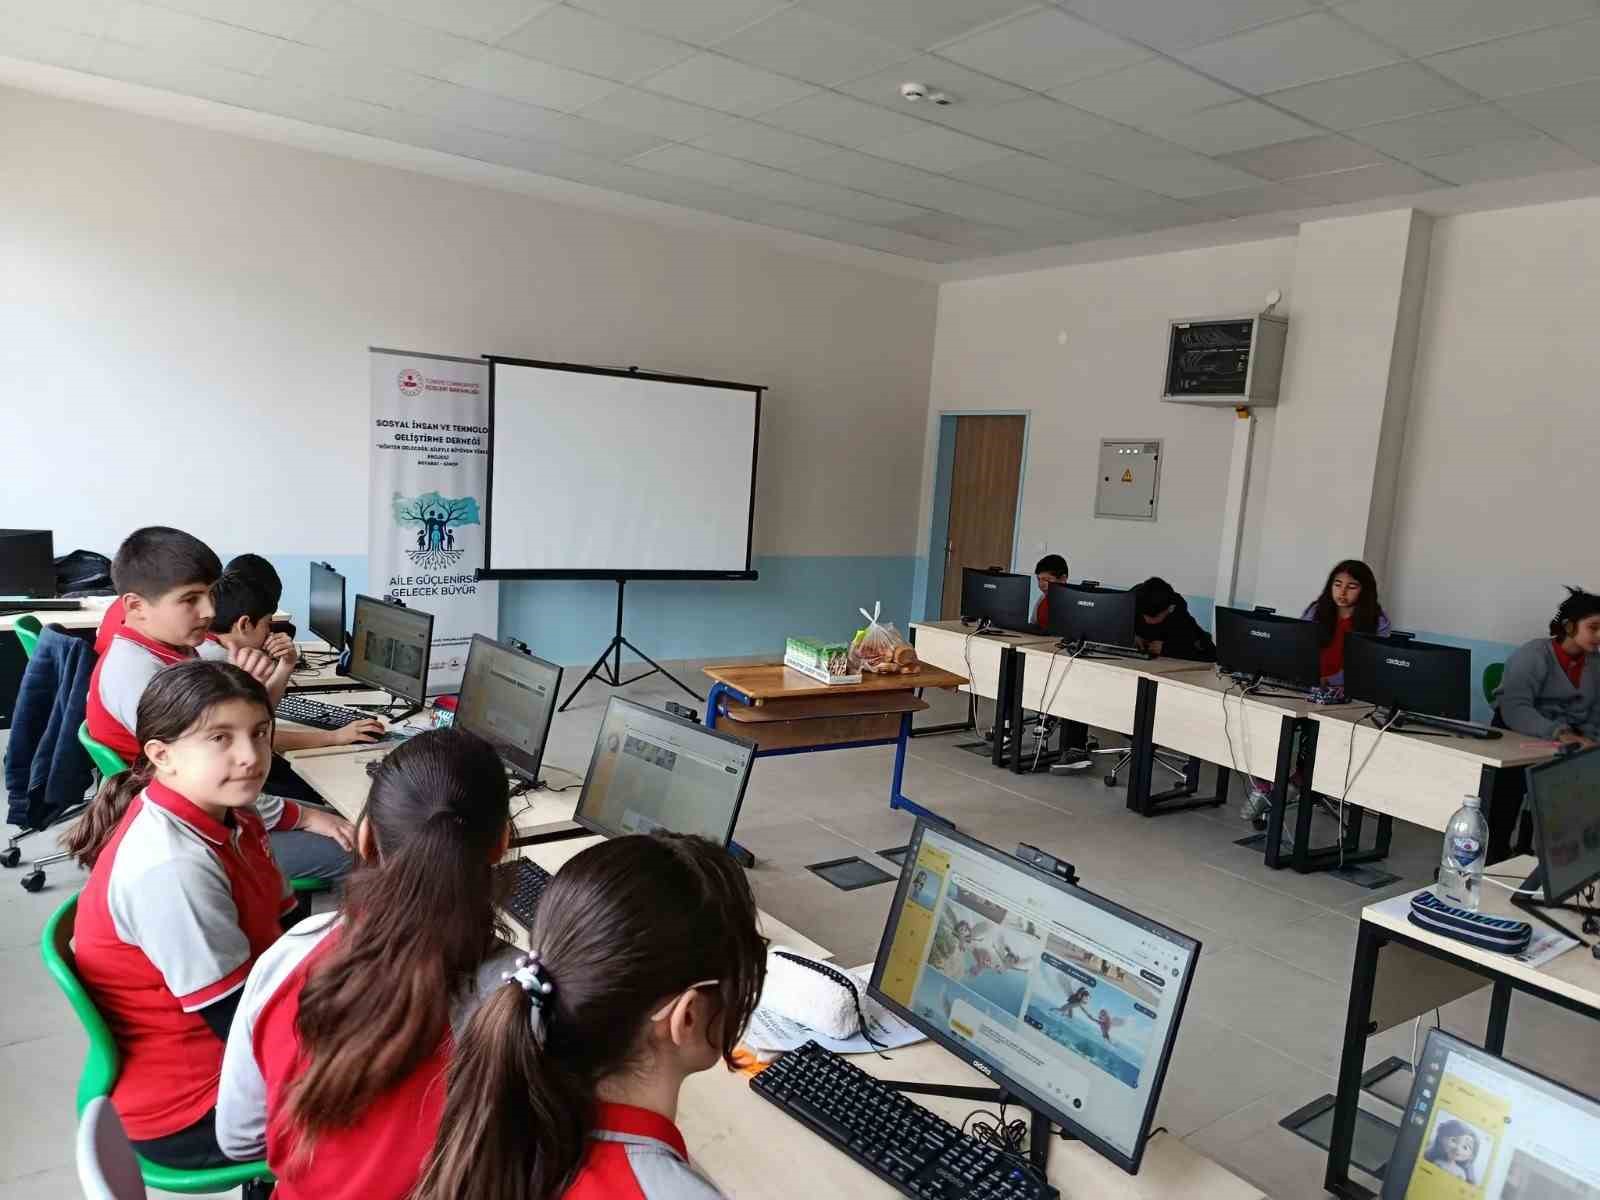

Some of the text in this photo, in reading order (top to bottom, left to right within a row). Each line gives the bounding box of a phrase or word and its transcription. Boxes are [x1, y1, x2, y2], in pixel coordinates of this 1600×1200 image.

[376, 419, 488, 434] SOSYAL İNSAN VE TEKNOLO
[394, 433, 481, 446] GELİŞTİRME DERNEĞİ
[389, 574, 414, 586] AİLE
[391, 584, 476, 597] GELECEK BÜYÜR
